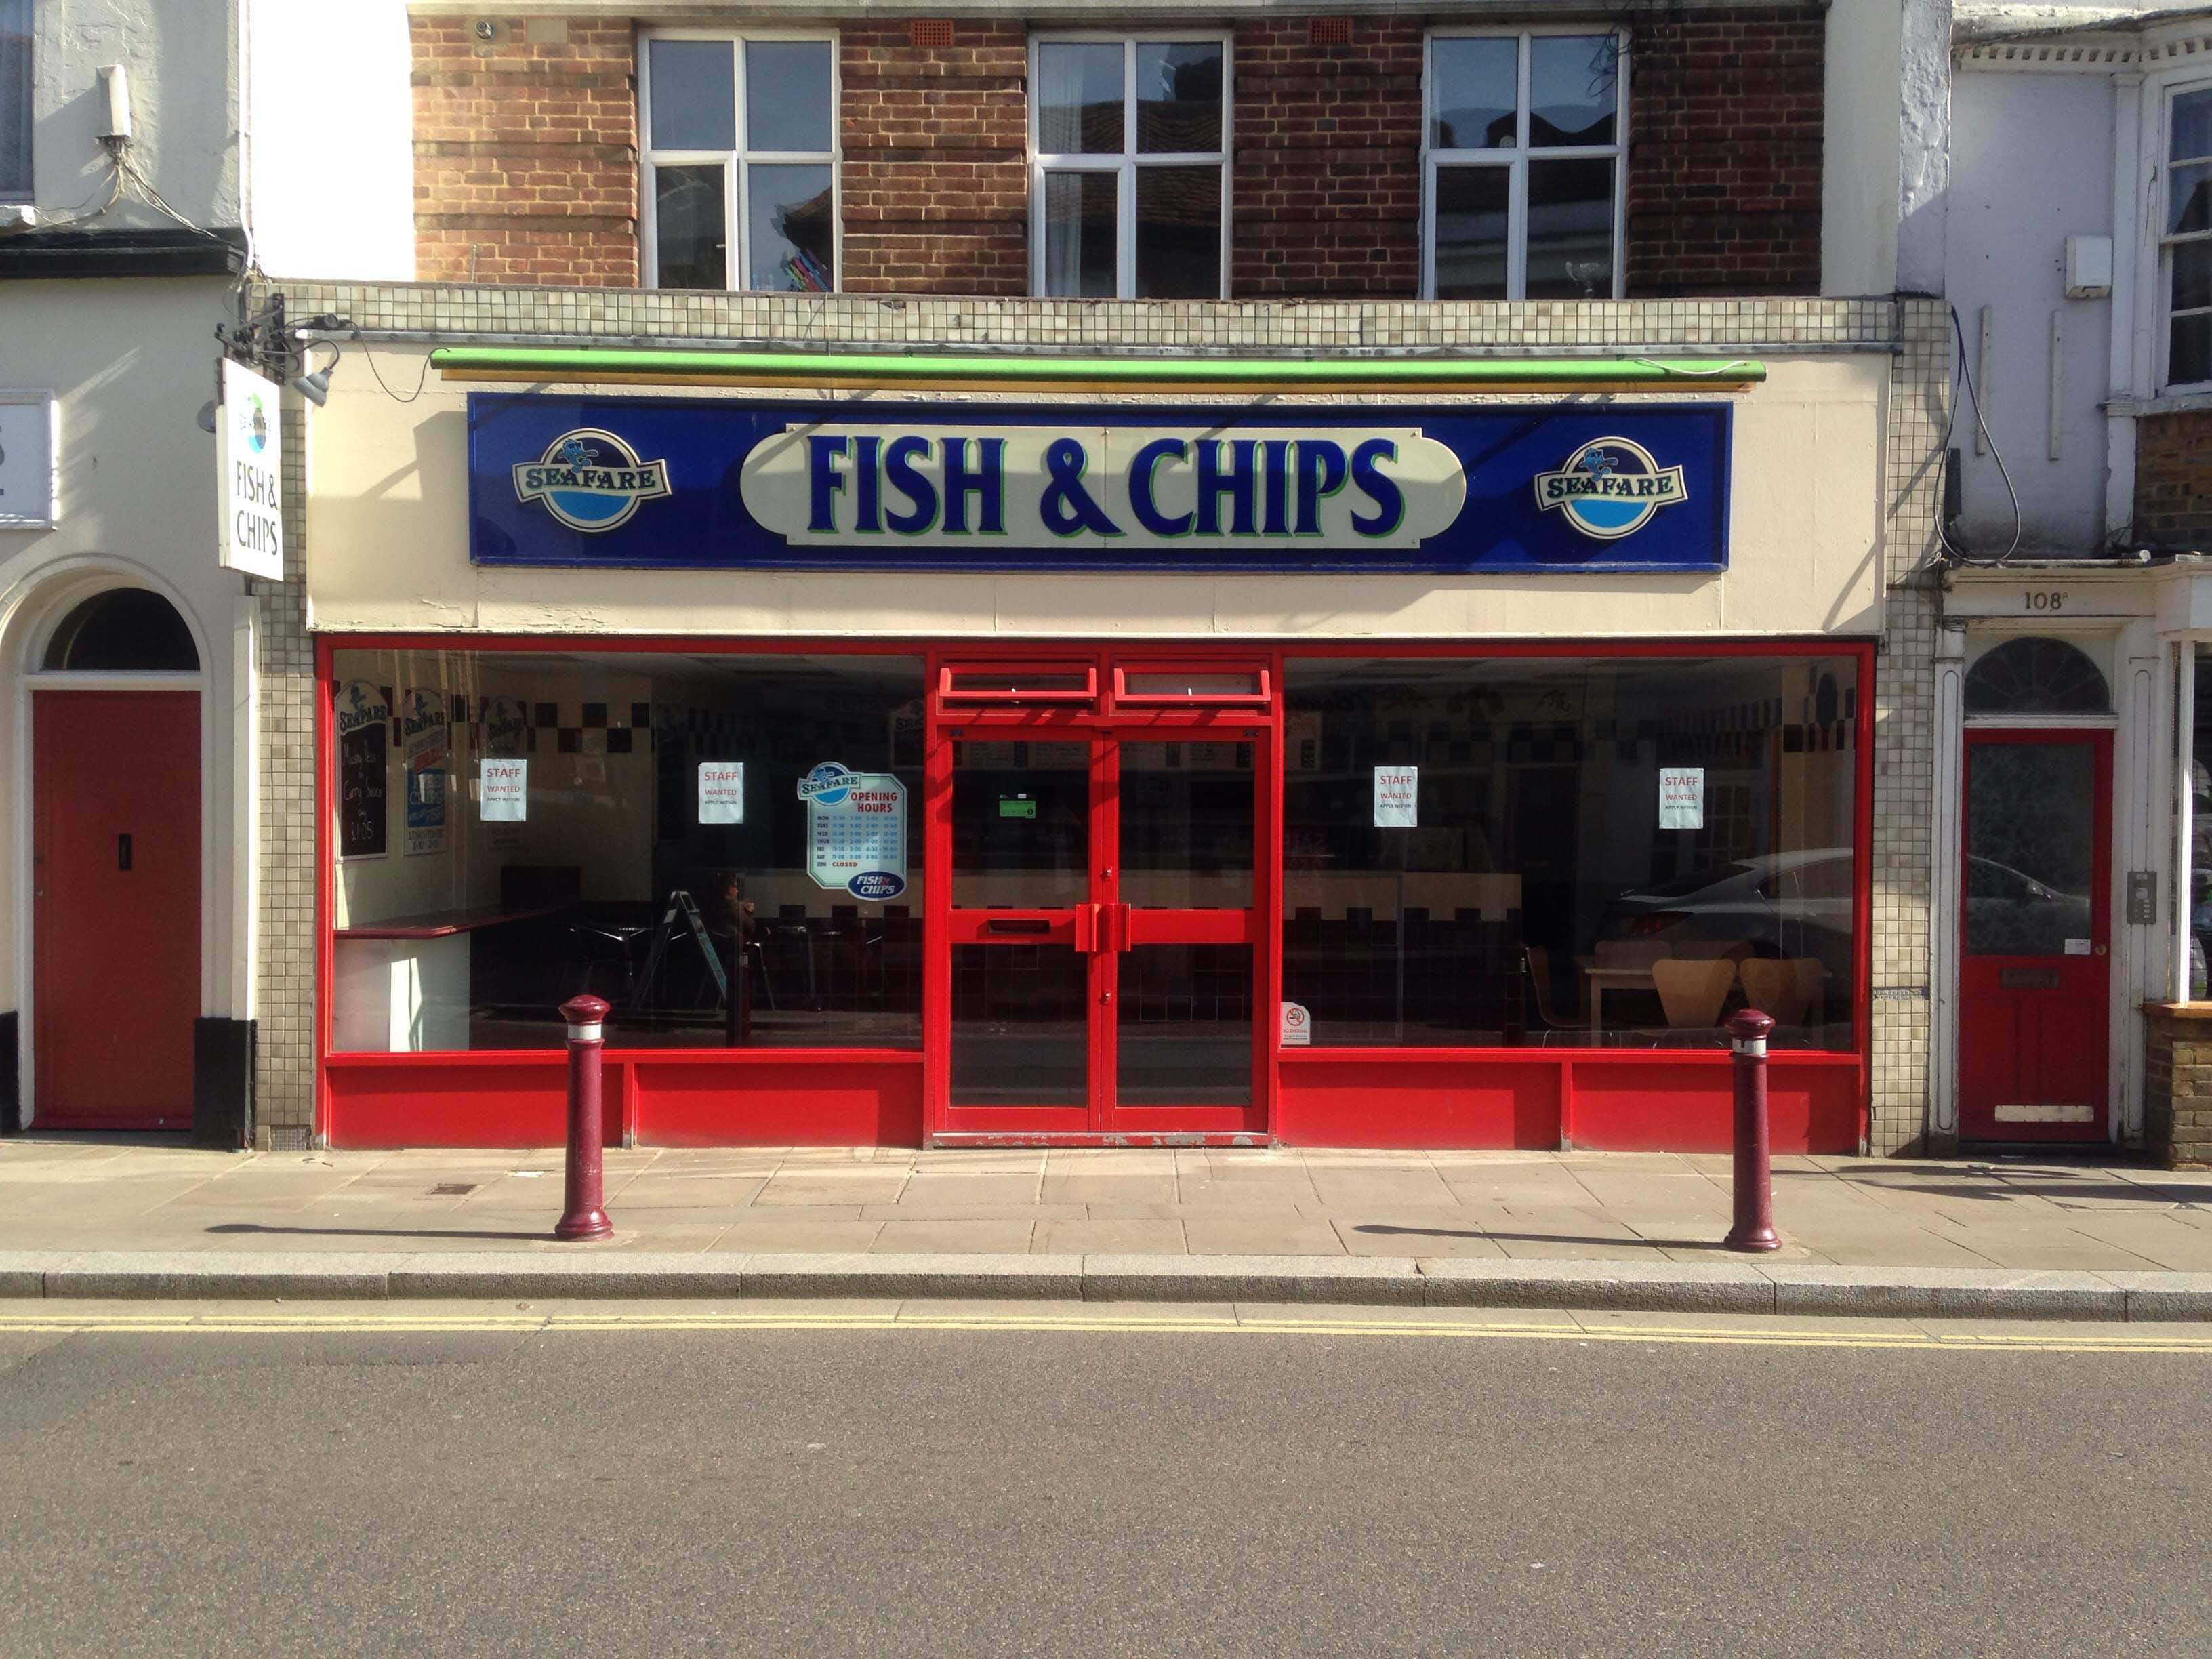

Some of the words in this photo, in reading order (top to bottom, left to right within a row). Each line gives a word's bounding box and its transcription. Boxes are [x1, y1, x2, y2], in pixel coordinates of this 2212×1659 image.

[525, 468, 657, 491] SEAFARE
[237, 461, 265, 506] FISH
[268, 474, 278, 510] &
[806, 435, 1008, 536] FISH
[1040, 436, 1128, 538] &
[1128, 437, 1407, 538] CHIPS
[1546, 475, 1674, 498] SEAFARE
[237, 509, 279, 556] CHIPS
[340, 704, 386, 732] SEAFARE
[487, 768, 521, 778] STAFF
[704, 771, 738, 781] STAFF
[1380, 775, 1412, 785] STAFF
[1665, 777, 1698, 786] STAFF
[802, 777, 858, 795] SEAFARE
[704, 788, 737, 796] WANTED
[851, 792, 898, 802] OPENING
[857, 803, 893, 813] HOURS
[856, 876, 882, 885] FISH
[860, 885, 895, 894] CHIPS
